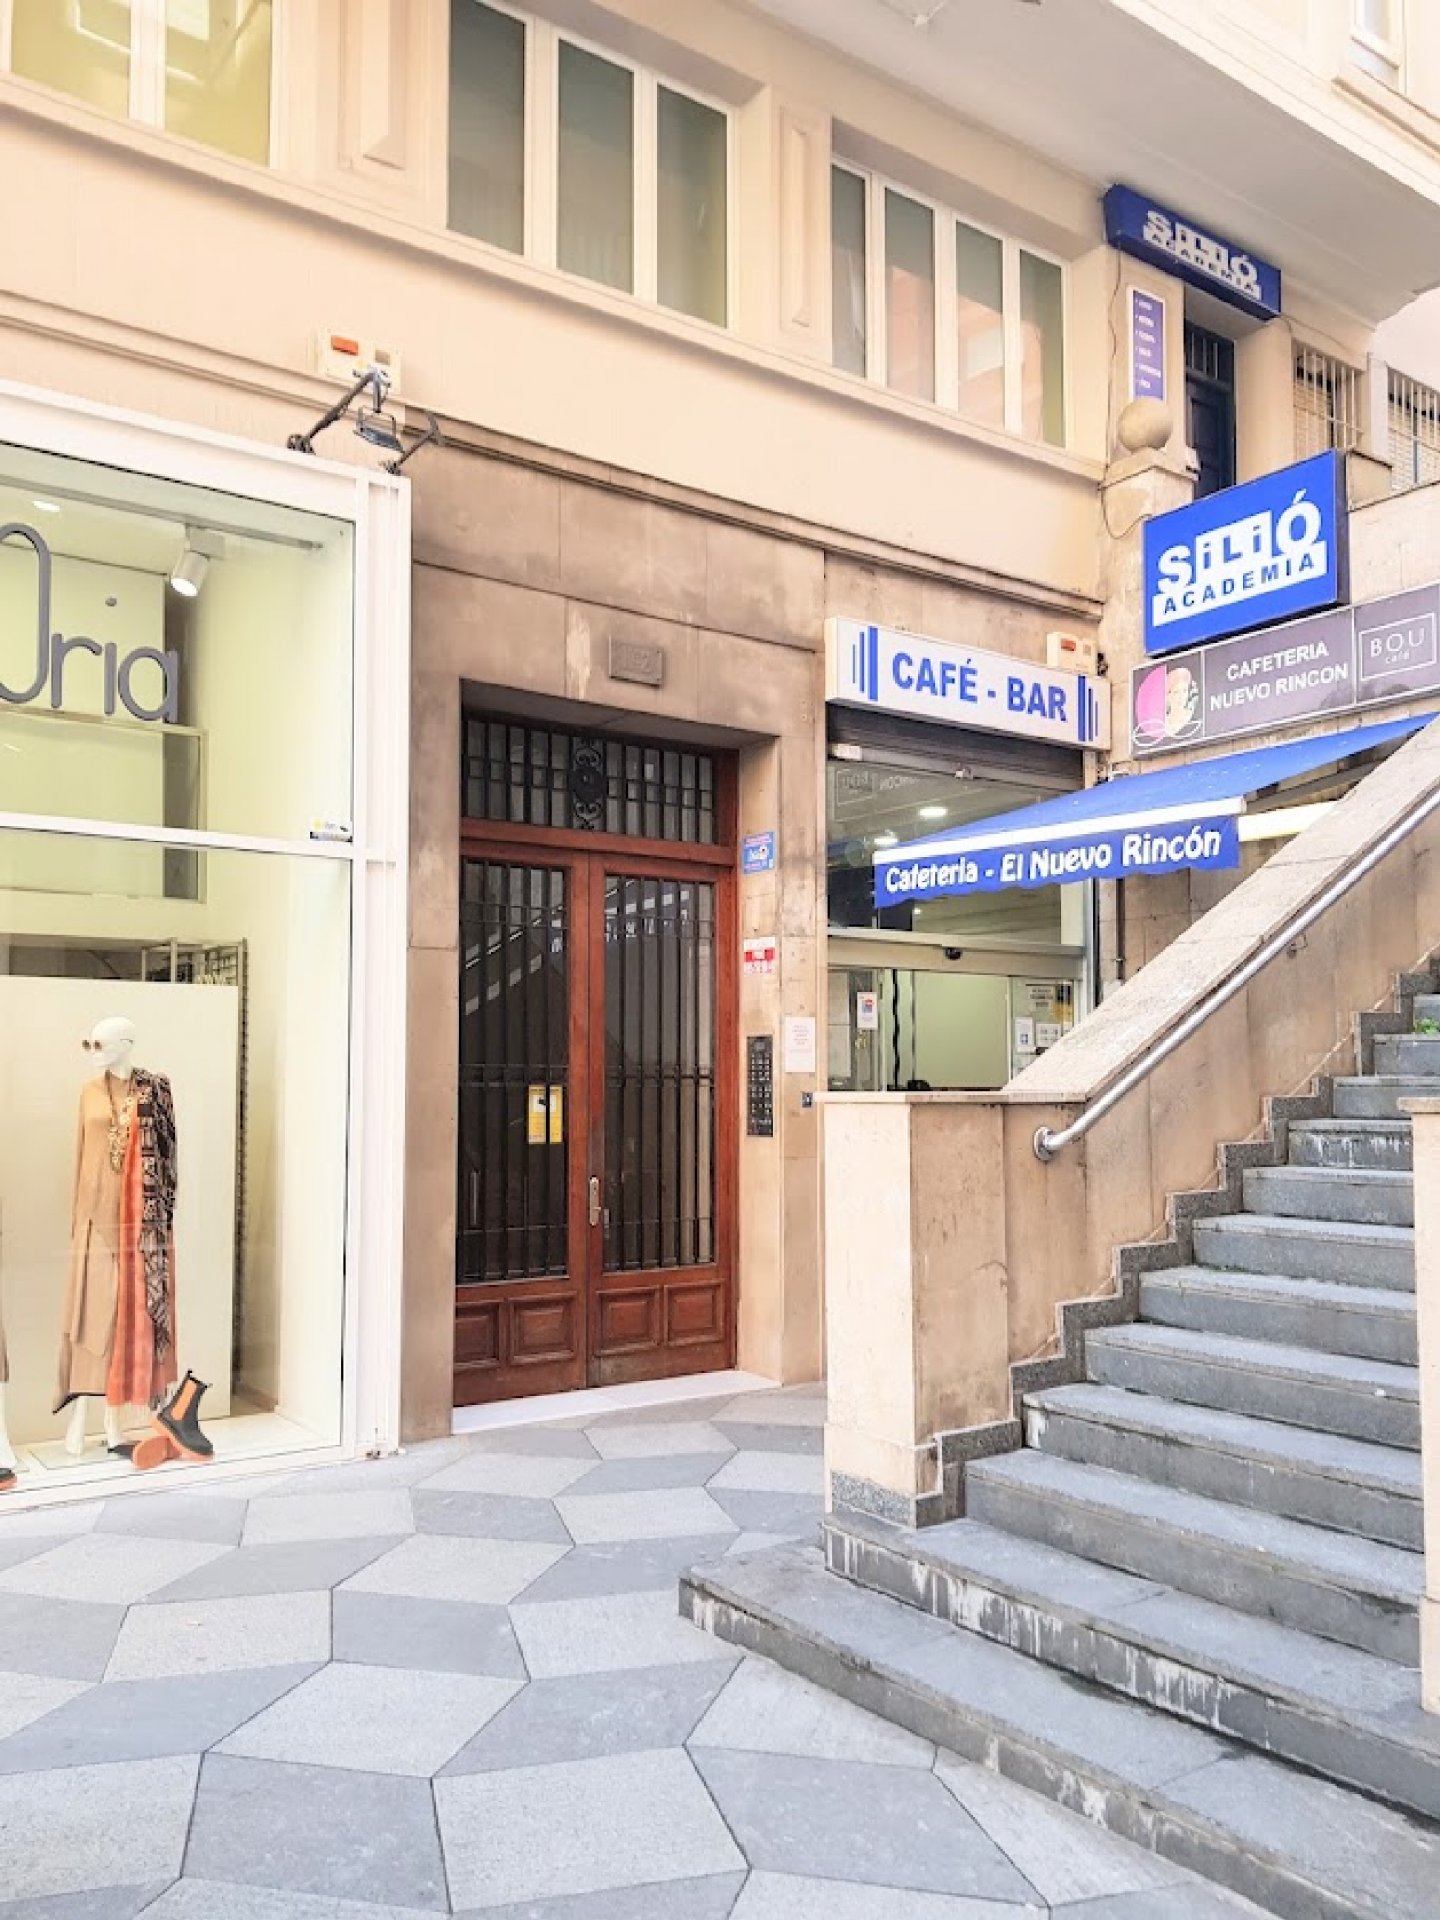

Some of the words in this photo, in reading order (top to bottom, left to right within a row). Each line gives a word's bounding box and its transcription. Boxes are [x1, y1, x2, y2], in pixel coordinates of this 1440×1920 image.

[1163, 552, 1315, 615] ACADEMIA
[1226, 640, 1329, 682] CAFETERIA
[1370, 627, 1425, 658] BOU
[892, 652, 978, 704] CAFÉ
[1007, 675, 1067, 722] BAR
[1210, 682, 1270, 711] NUEVO
[1275, 663, 1349, 696] RINCON
[885, 857, 978, 892] Cafeteria
[1001, 853, 1023, 882] El
[1029, 842, 1112, 880] Nuevo
[1122, 823, 1222, 867] Rincón
